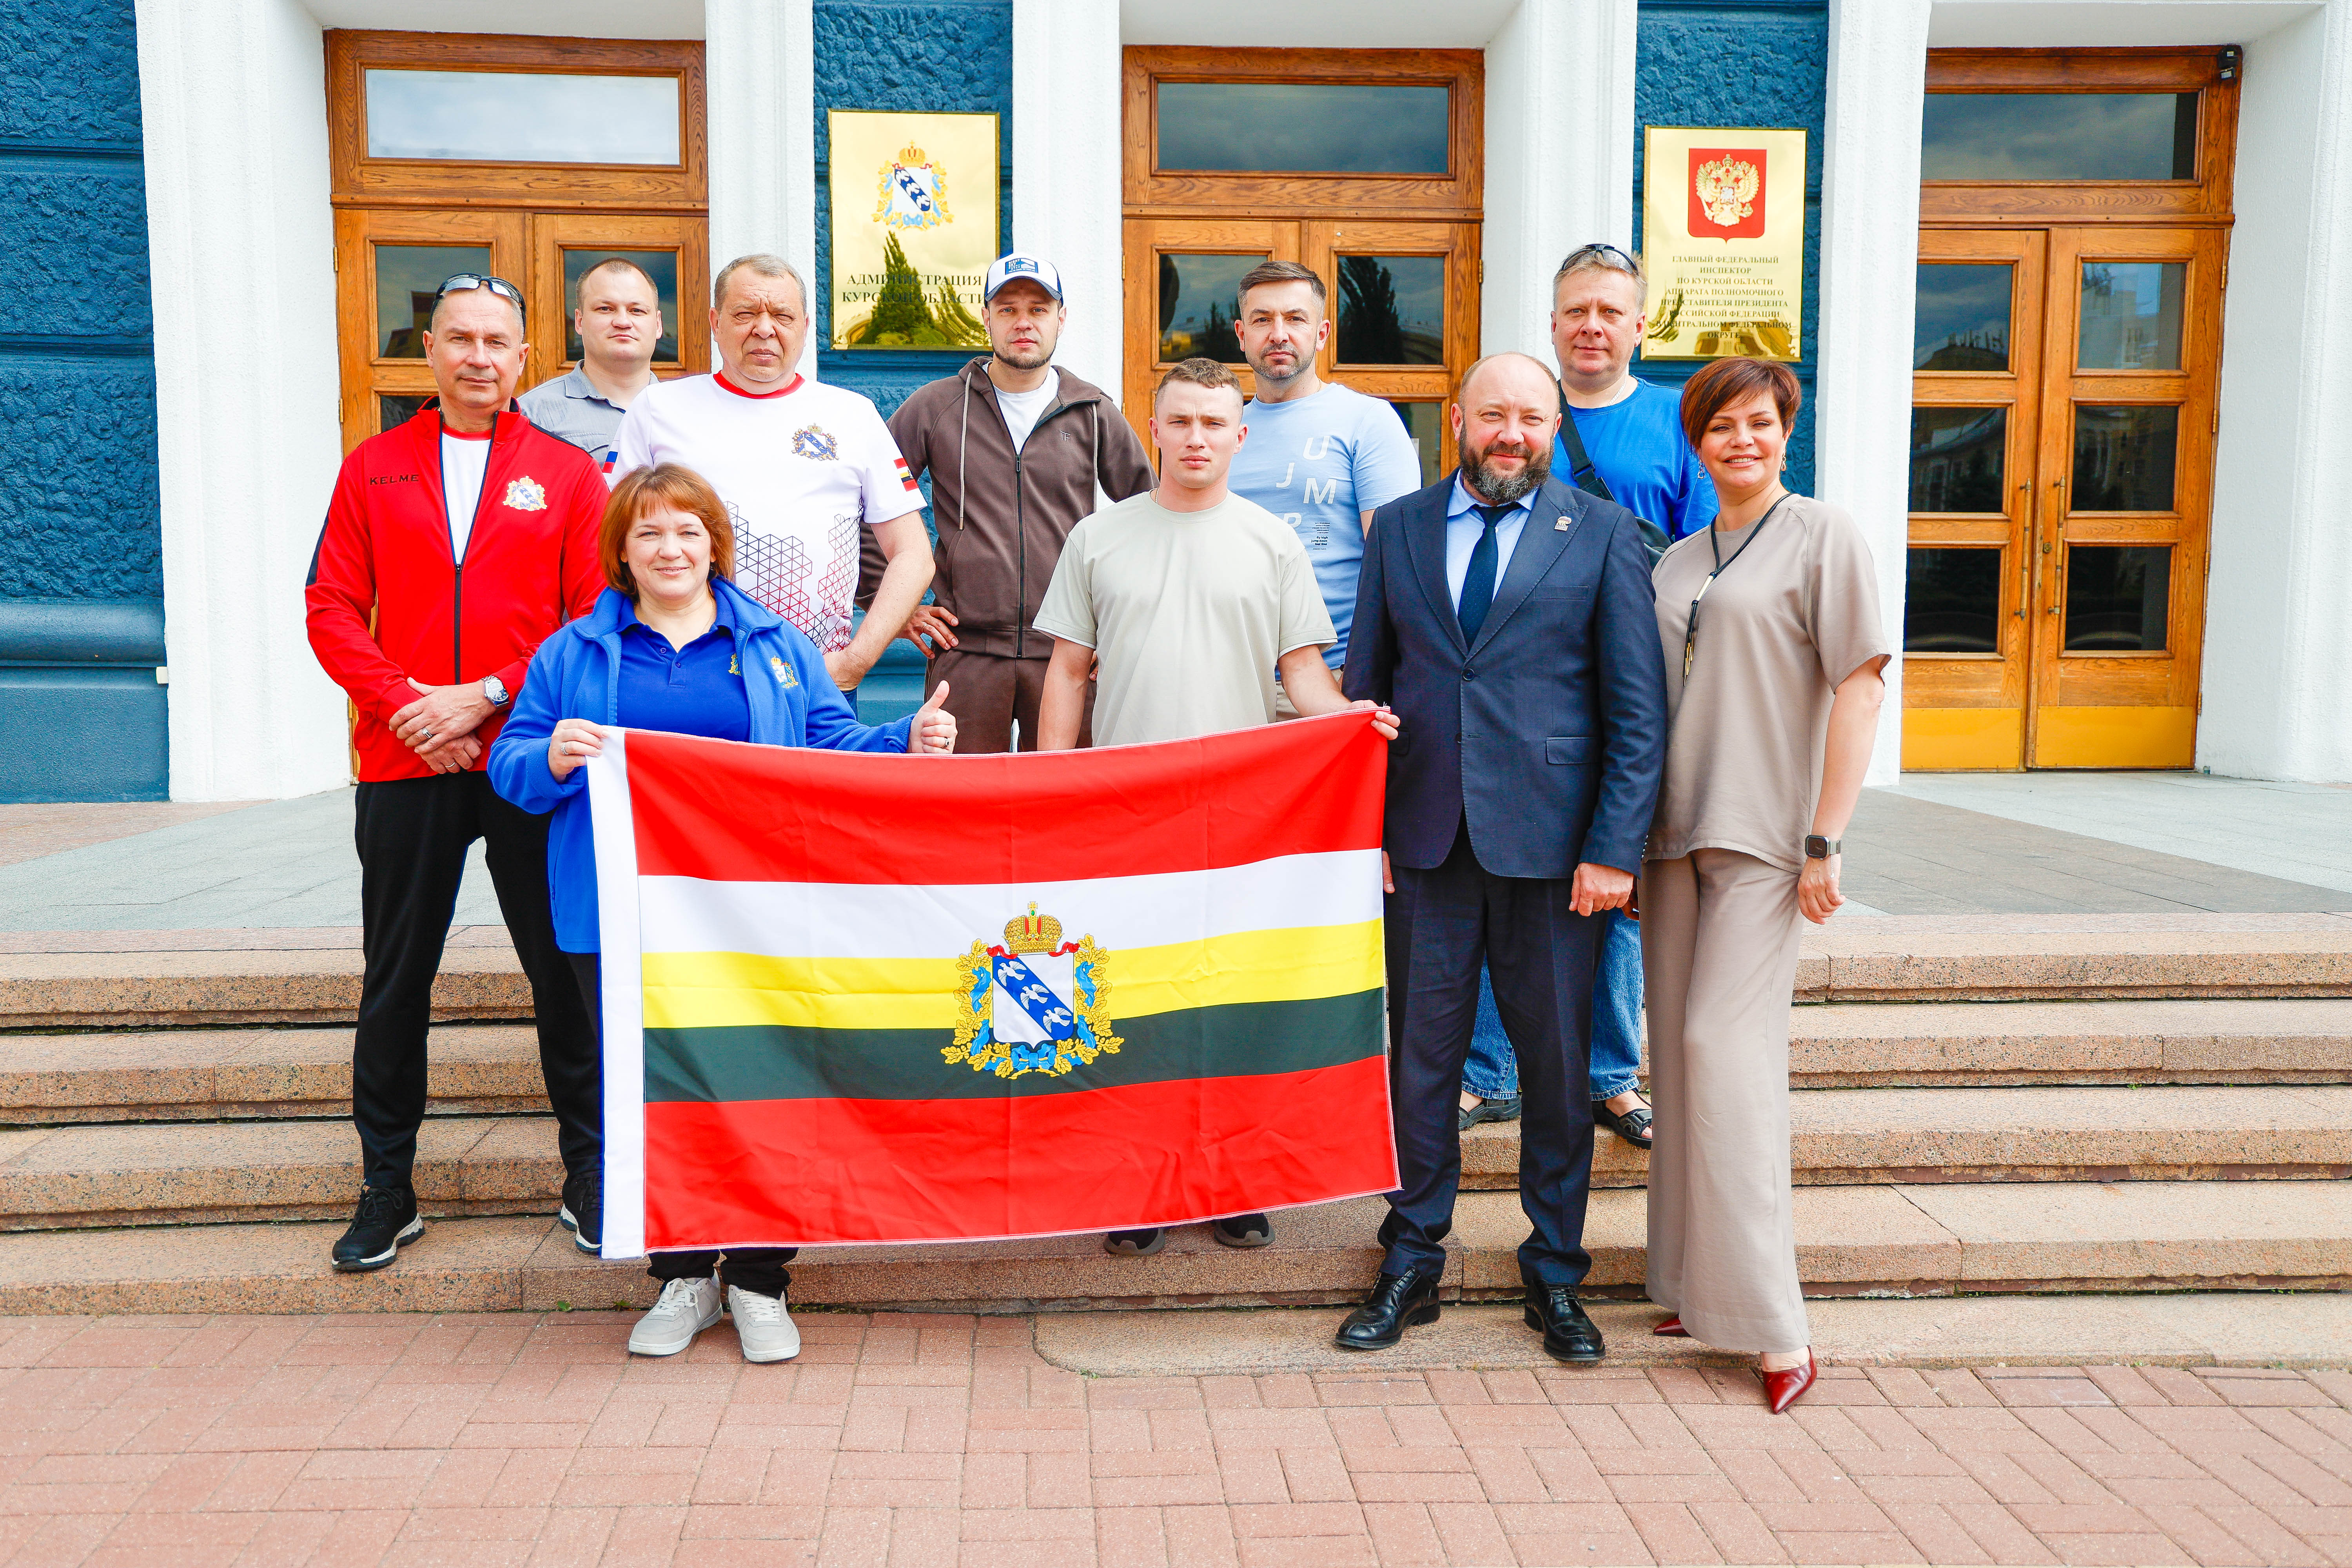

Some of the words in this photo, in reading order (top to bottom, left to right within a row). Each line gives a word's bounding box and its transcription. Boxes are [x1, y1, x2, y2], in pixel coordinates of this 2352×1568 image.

[847, 274, 982, 288] АДМИНИСТРАЦИЯ
[1303, 436, 1330, 460] U
[369, 474, 419, 485] KELME
[1276, 462, 1295, 488] J
[1303, 477, 1337, 504] M
